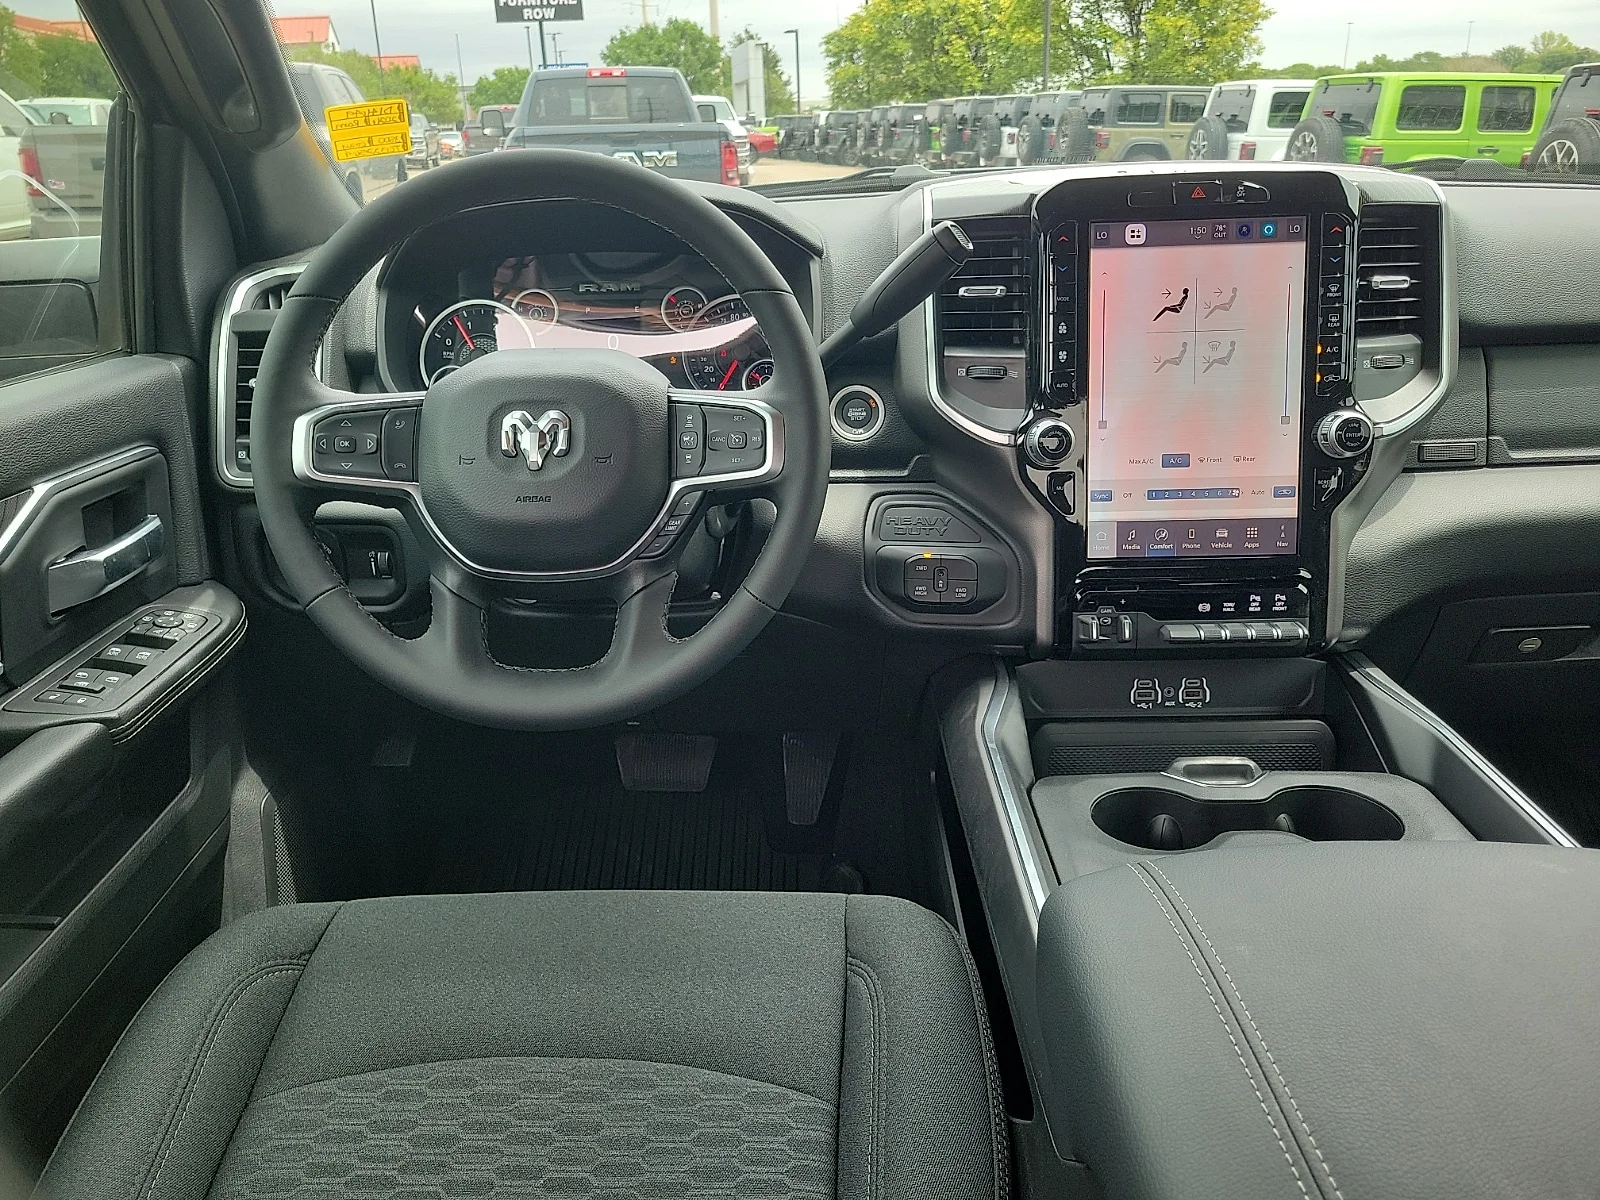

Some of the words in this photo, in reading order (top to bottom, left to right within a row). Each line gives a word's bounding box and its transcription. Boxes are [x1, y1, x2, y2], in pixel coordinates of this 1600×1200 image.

[522, 7, 556, 20] ROW
[613, 151, 678, 167] AM
[1190, 226, 1207, 235] 1:50
[1289, 224, 1301, 233] LO
[1096, 231, 1108, 239] LO
[578, 283, 640, 292] RAM
[730, 313, 740, 321] 80
[467, 321, 472, 330] 1
[445, 338, 452, 346] 0
[607, 334, 619, 350] 0
[515, 495, 552, 503] AIRBAG
[886, 515, 952, 526] HEAVY
[893, 526, 948, 536] DUTY
